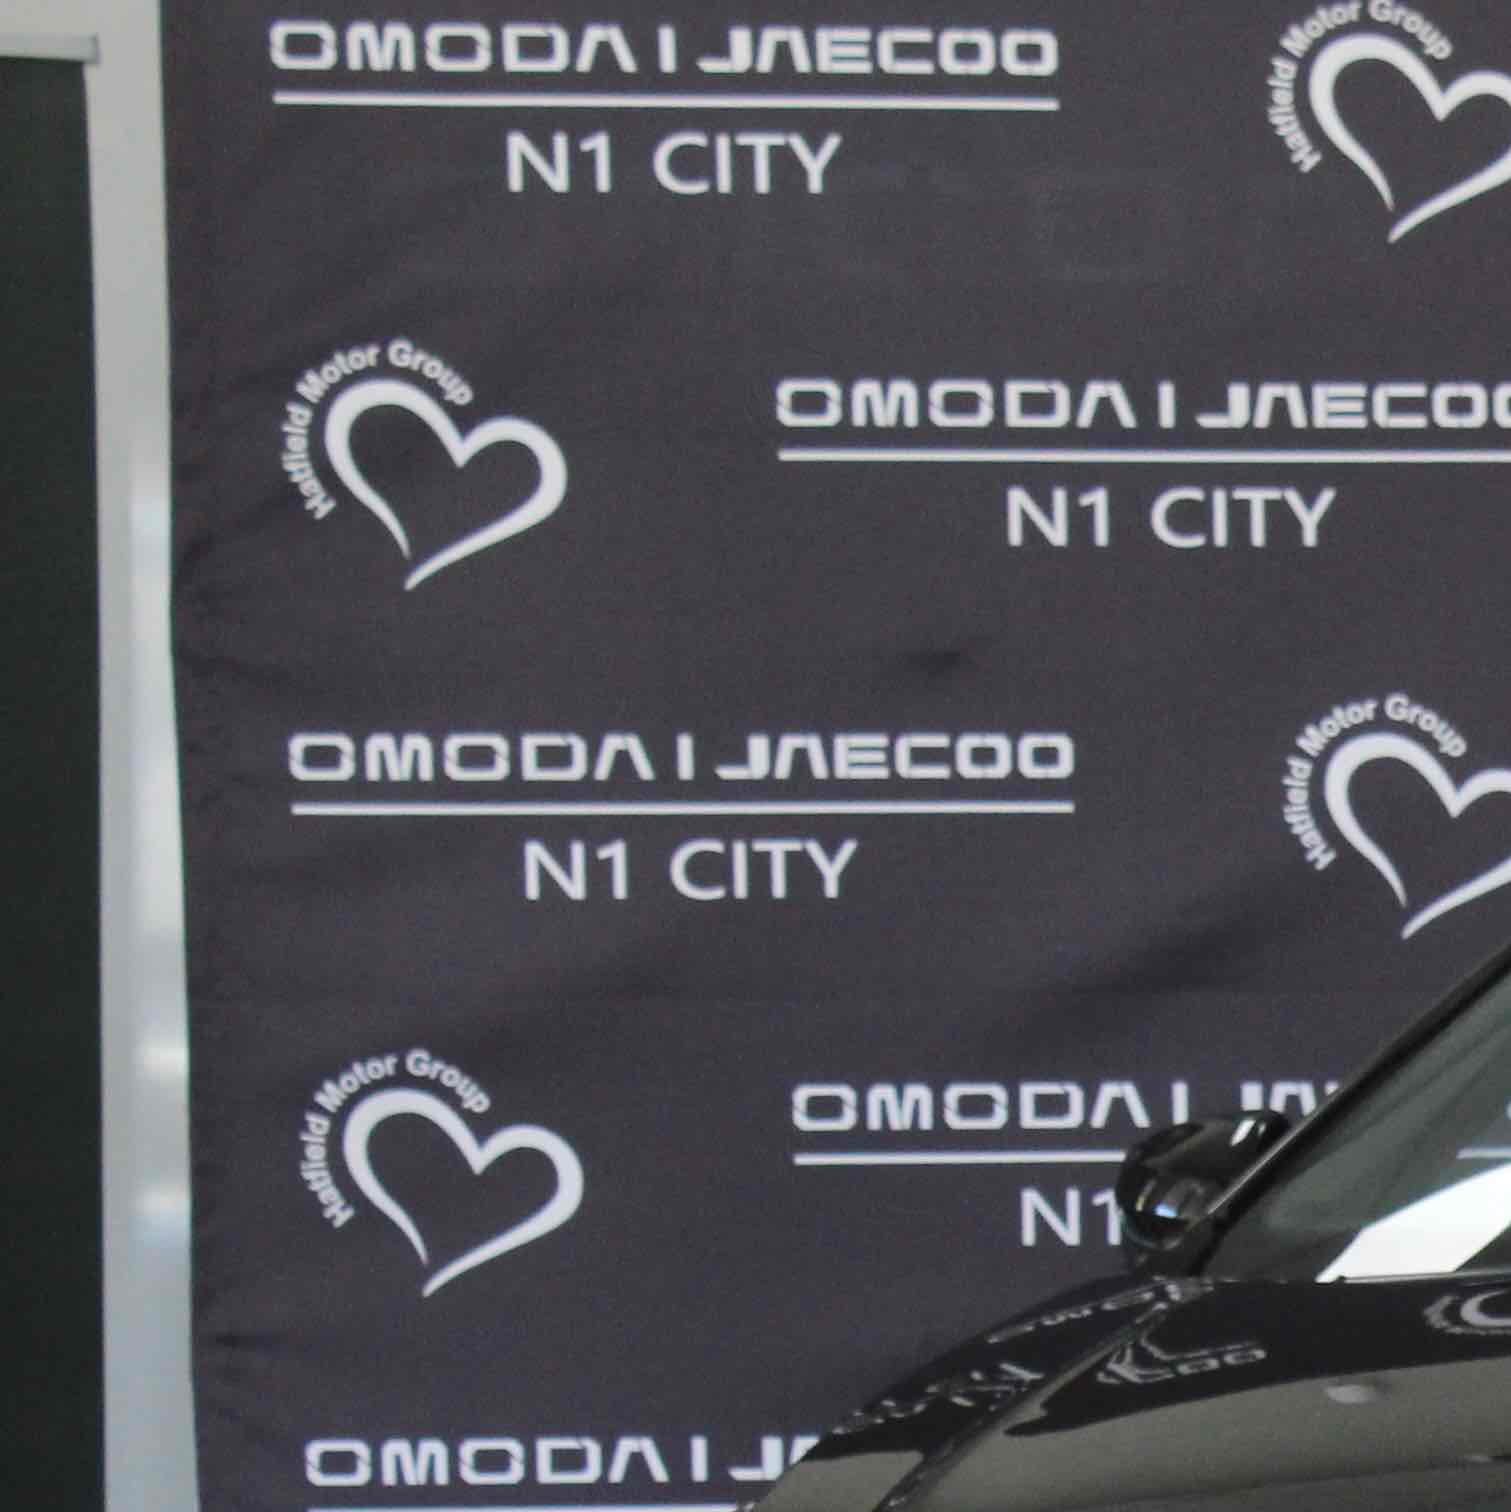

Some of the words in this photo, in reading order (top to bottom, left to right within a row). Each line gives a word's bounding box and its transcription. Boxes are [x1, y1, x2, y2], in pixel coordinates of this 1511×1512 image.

[269, 21, 637, 73] OMODA
[697, 27, 1058, 76] JAECOO
[1280, 1, 1361, 58] Motor
[1368, 0, 1453, 60] Group
[1267, 56, 1322, 172] Hatfield
[507, 131, 611, 193] N1
[653, 132, 841, 195] CITY
[296, 345, 381, 403] Motor
[388, 337, 473, 405] Group
[776, 379, 1136, 428] OMODA
[281, 401, 336, 519] Hatfield
[1007, 487, 1109, 547] N1
[1151, 487, 1336, 548] CITY
[1295, 699, 1378, 757] Motor
[1384, 693, 1467, 757] Group
[288, 733, 654, 782] OMODA
[715, 733, 1074, 780] JAECOO
[1282, 756, 1336, 870] Hatfield
[524, 839, 627, 901] N1
[670, 839, 857, 901] CITY
[313, 1054, 398, 1112] Motor
[405, 1049, 490, 1113] Group
[792, 1081, 1150, 1132] OMODA
[300, 1111, 354, 1228] Hatfield
[1021, 1188, 1123, 1247] N1
[305, 1436, 669, 1487] OMODA
